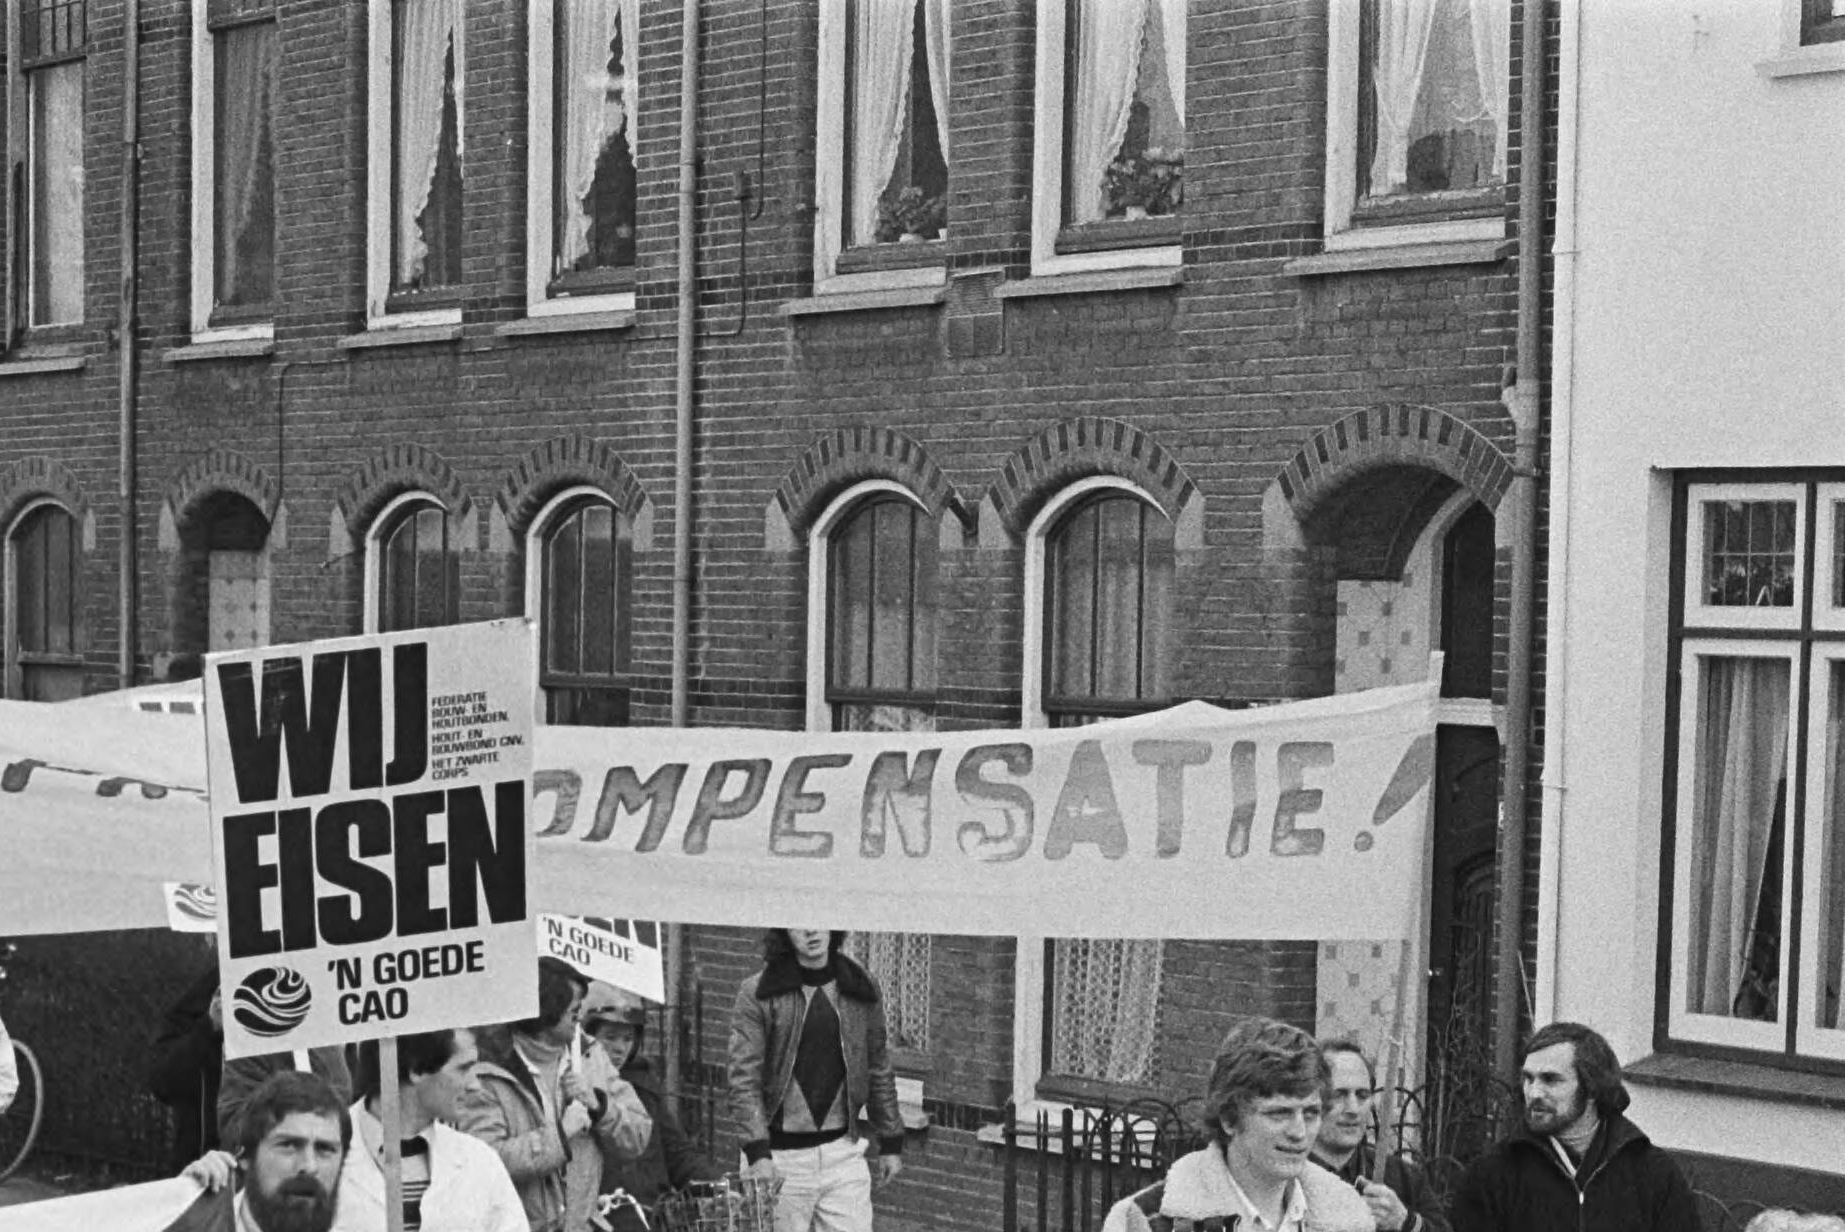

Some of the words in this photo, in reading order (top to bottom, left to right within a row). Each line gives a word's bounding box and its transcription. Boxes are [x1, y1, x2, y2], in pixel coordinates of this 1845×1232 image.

[217, 642, 428, 804] WIJ
[472, 702, 487, 714] EN
[468, 728, 483, 740] EN
[223, 780, 527, 959] EISEN
[373, 940, 485, 983] GOEDE
[548, 937, 591, 966] CAO
[569, 926, 635, 964] GOEDE
[338, 987, 409, 1026] CAO
